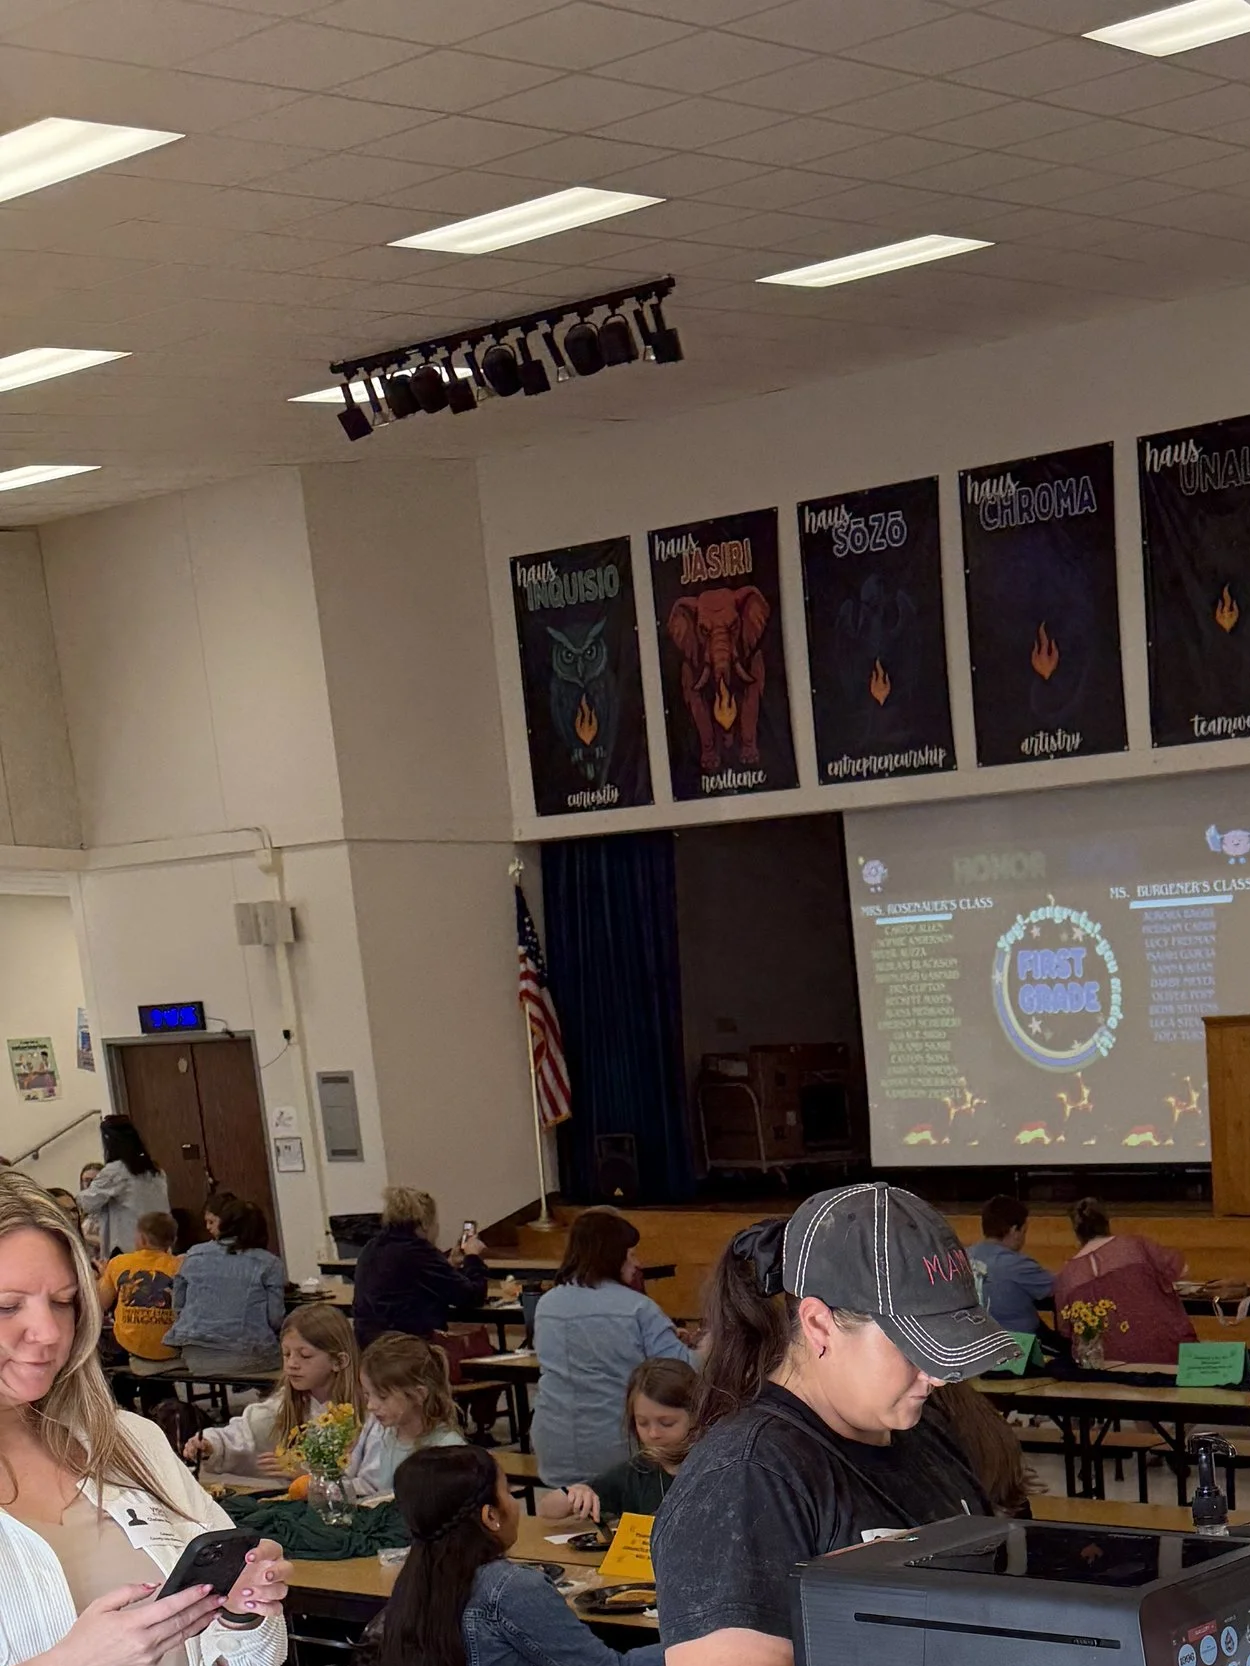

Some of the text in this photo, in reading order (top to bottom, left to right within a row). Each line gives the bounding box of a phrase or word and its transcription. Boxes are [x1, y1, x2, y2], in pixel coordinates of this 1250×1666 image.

[1145, 438, 1202, 473] haus
[967, 471, 1019, 505] haus
[978, 475, 1097, 531] CHROMA
[804, 504, 851, 534] haus
[654, 531, 698, 562] haus
[680, 537, 752, 585] JASIRI
[516, 560, 558, 590] haus
[526, 564, 620, 611] INQUISIO
[1021, 729, 1083, 755] artistry
[827, 744, 946, 778] entrepreneurship
[567, 784, 619, 808] curiosity
[701, 770, 767, 793] resilience
[959, 897, 993, 910] CLASS
[1110, 887, 1130, 899] MS.
[1137, 881, 1210, 897] BURGENER'S
[1017, 947, 1087, 980] FIRST
[1018, 981, 1101, 1015] GRADE
